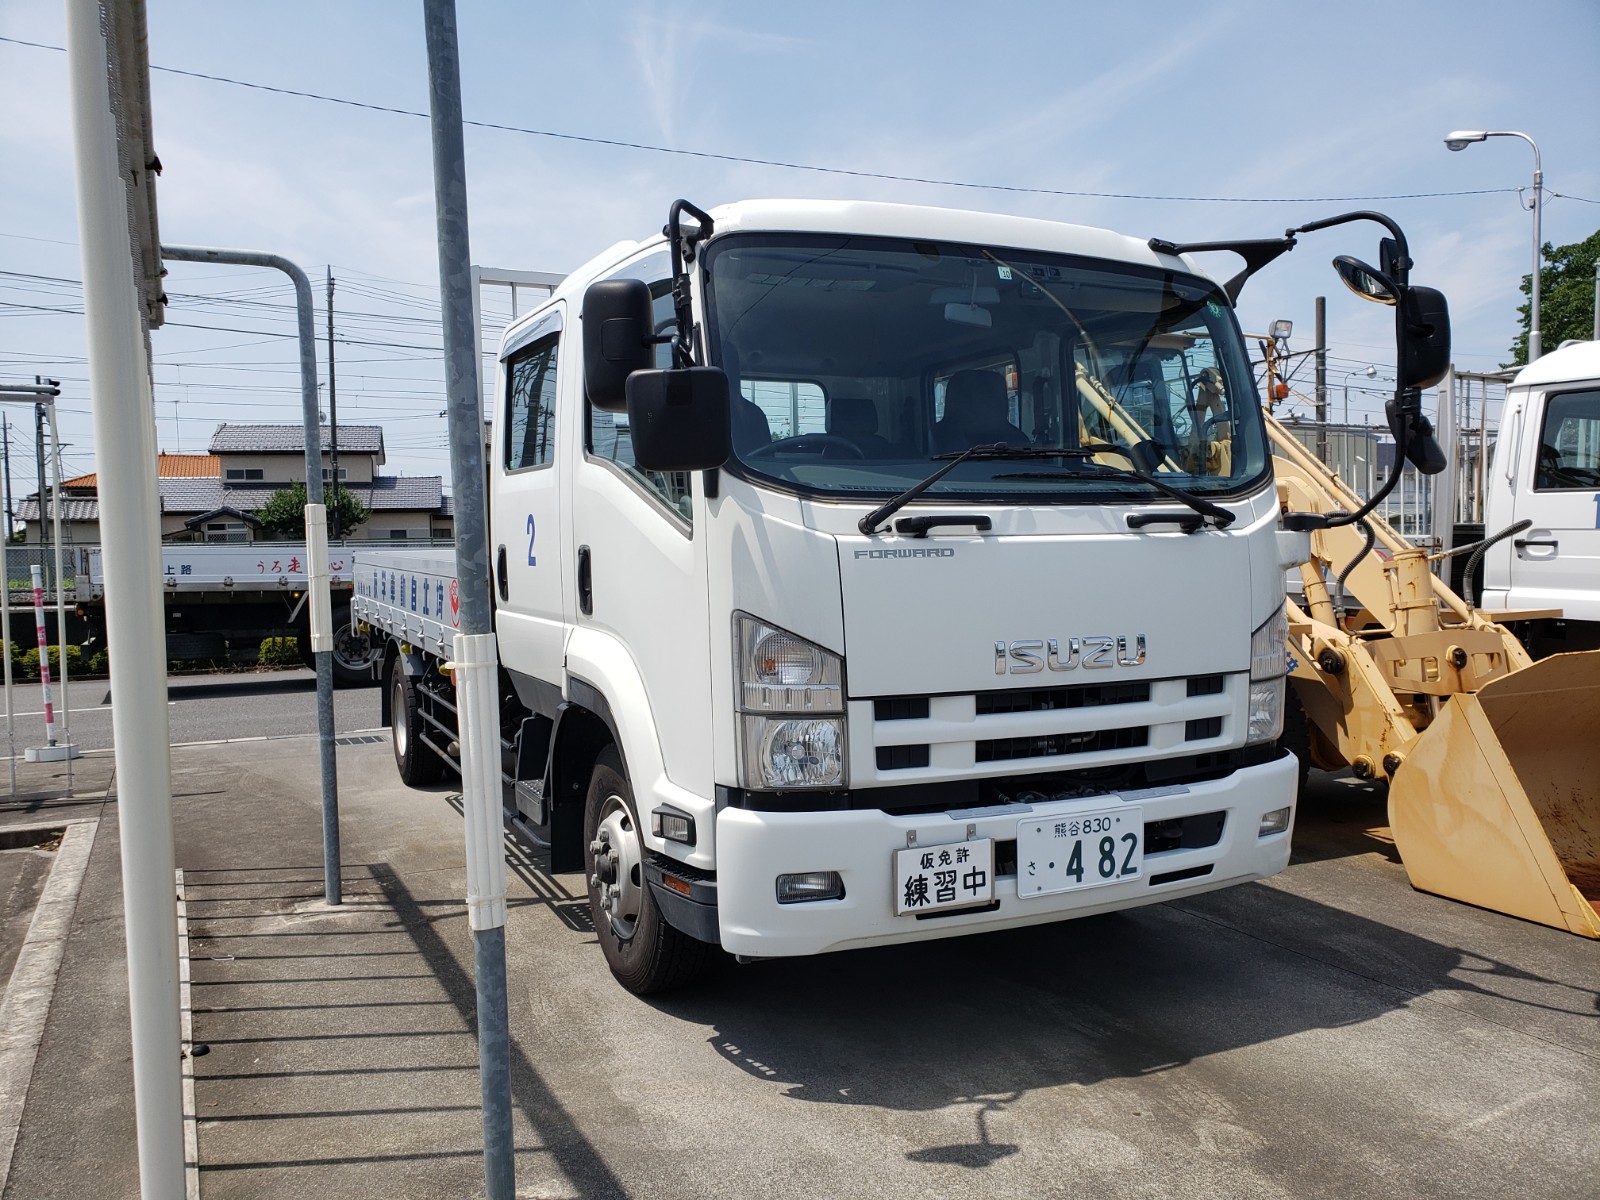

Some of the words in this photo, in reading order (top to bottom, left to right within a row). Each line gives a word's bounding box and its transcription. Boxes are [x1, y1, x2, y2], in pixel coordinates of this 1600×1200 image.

[526, 513, 537, 567] 2
[854, 547, 955, 560] FORWARD
[994, 633, 1147, 675] ISUZU
[920, 847, 970, 870] 仮免許
[1027, 861, 1036, 876] さ
[903, 865, 986, 908] 練習中
